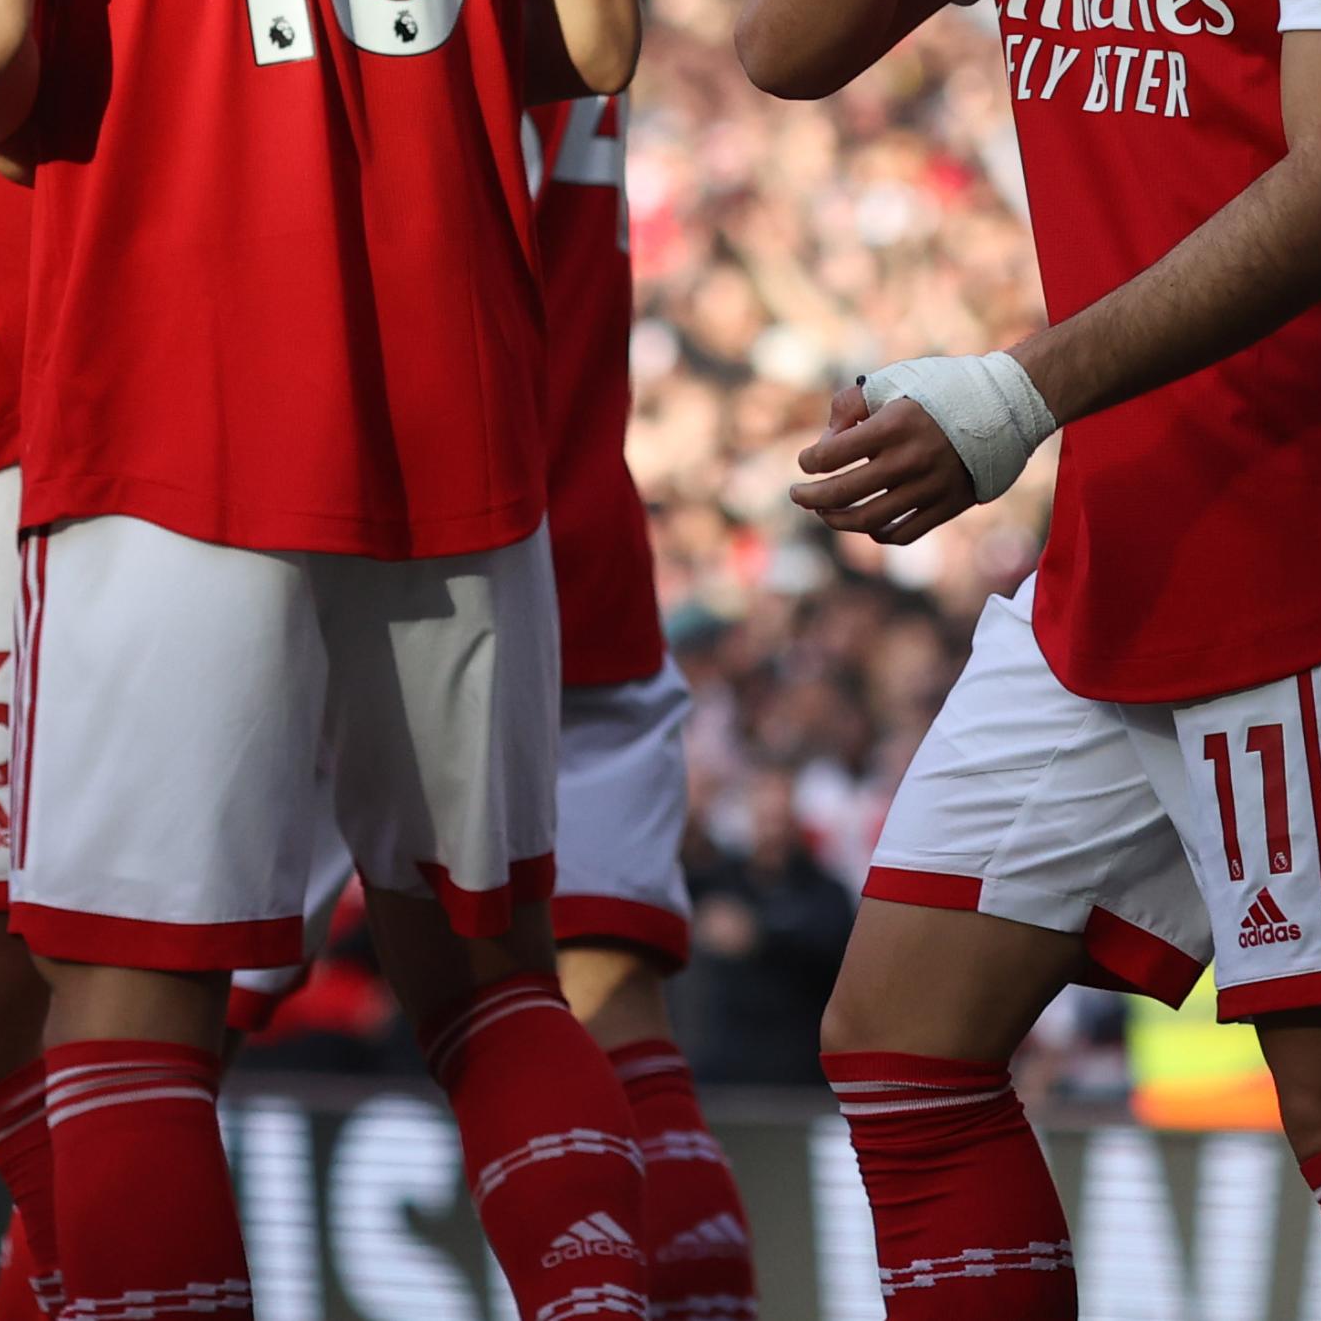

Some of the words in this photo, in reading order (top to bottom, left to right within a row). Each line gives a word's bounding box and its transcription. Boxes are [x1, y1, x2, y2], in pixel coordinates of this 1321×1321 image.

[1005, 33, 1081, 101] FLY
[1203, 723, 1294, 882] 11
[1239, 923, 1302, 949] adidas
